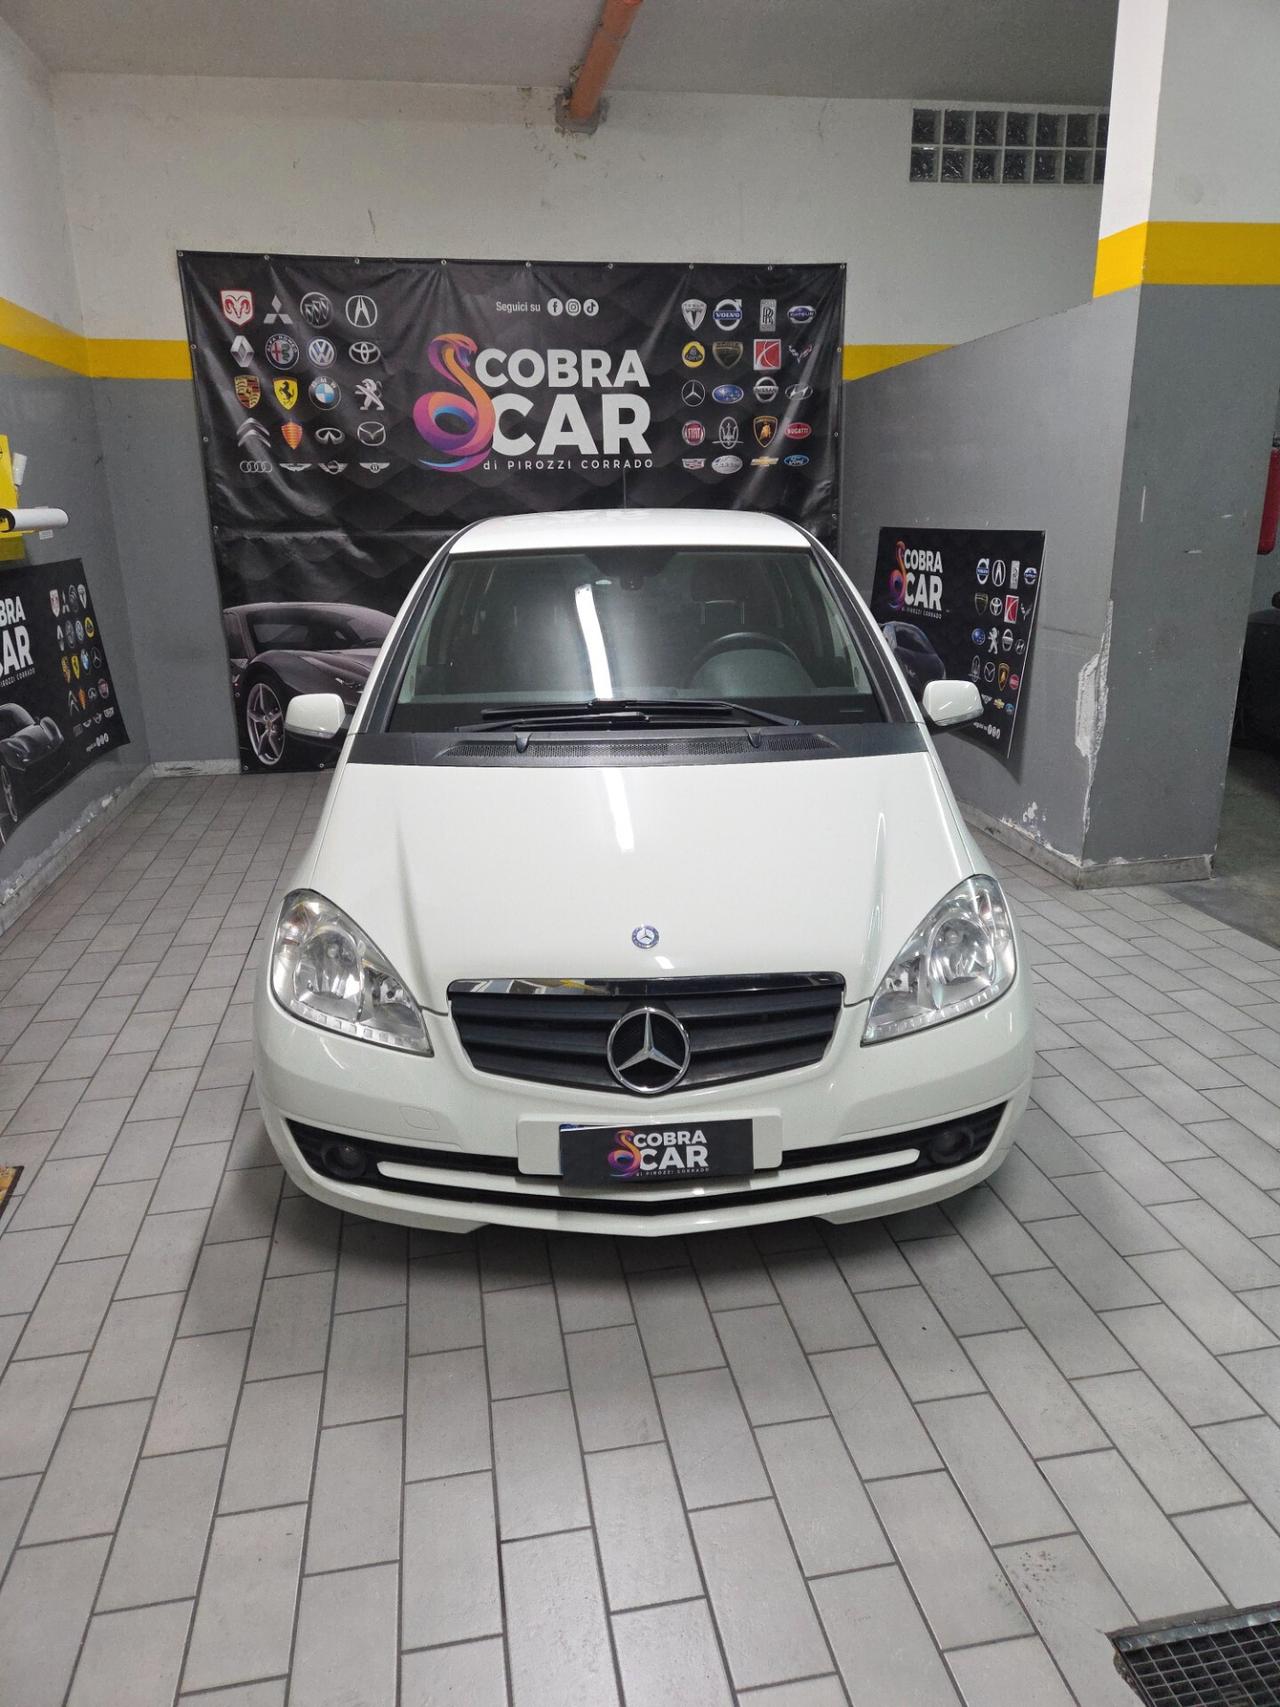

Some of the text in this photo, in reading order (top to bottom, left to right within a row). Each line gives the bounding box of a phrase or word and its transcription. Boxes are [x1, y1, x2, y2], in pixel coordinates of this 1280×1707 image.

[496, 301, 541, 313] Seguici su
[474, 348, 651, 388] COBRA
[491, 393, 652, 456] CAR
[483, 459, 653, 470] di PIROZZI CORRADO
[904, 548, 943, 573] COBRA
[904, 572, 942, 611] CAR
[0, 625, 34, 676] AR
[633, 1130, 707, 1147] COBRA
[640, 1145, 709, 1170] CAR
